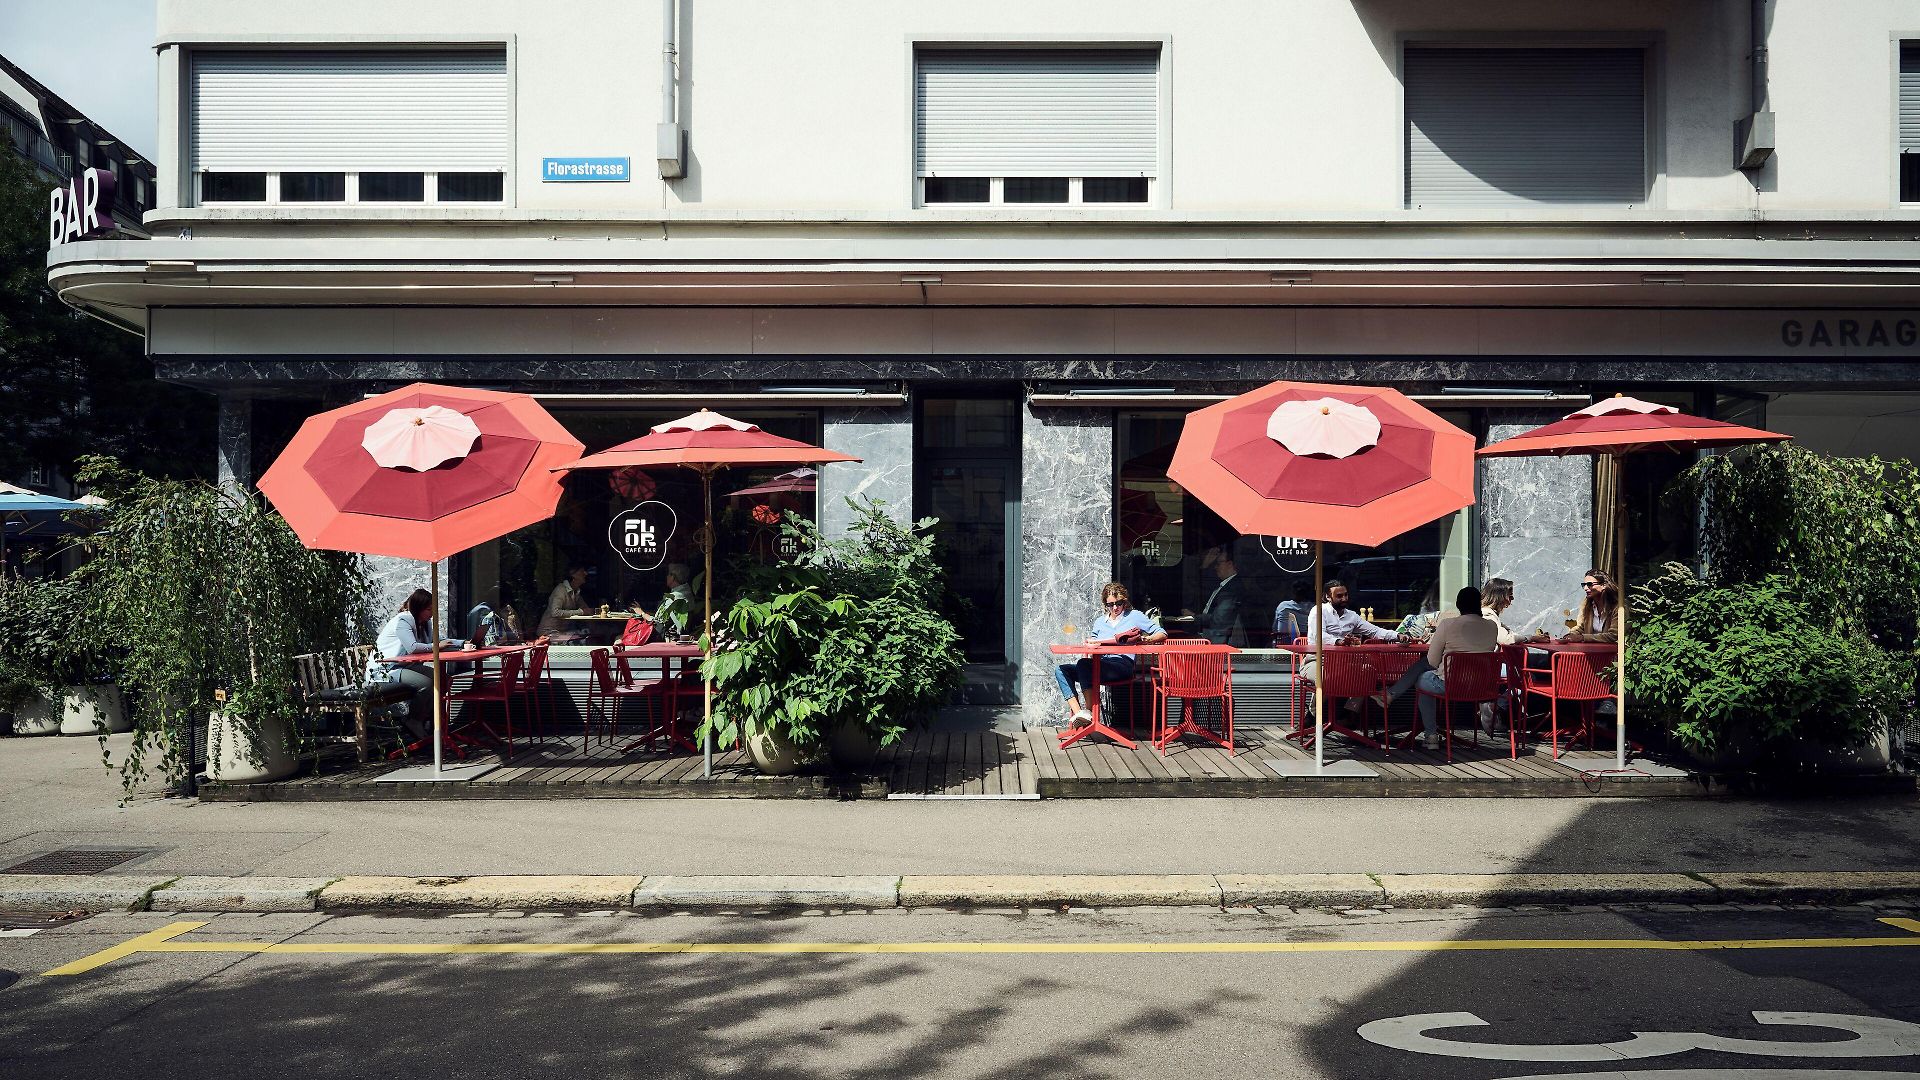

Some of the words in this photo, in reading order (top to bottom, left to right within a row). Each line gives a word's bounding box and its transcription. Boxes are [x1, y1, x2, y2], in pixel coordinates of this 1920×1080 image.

[547, 161, 624, 175] Florastrasse
[50, 167, 99, 249] BAR
[625, 533, 657, 547] OR
